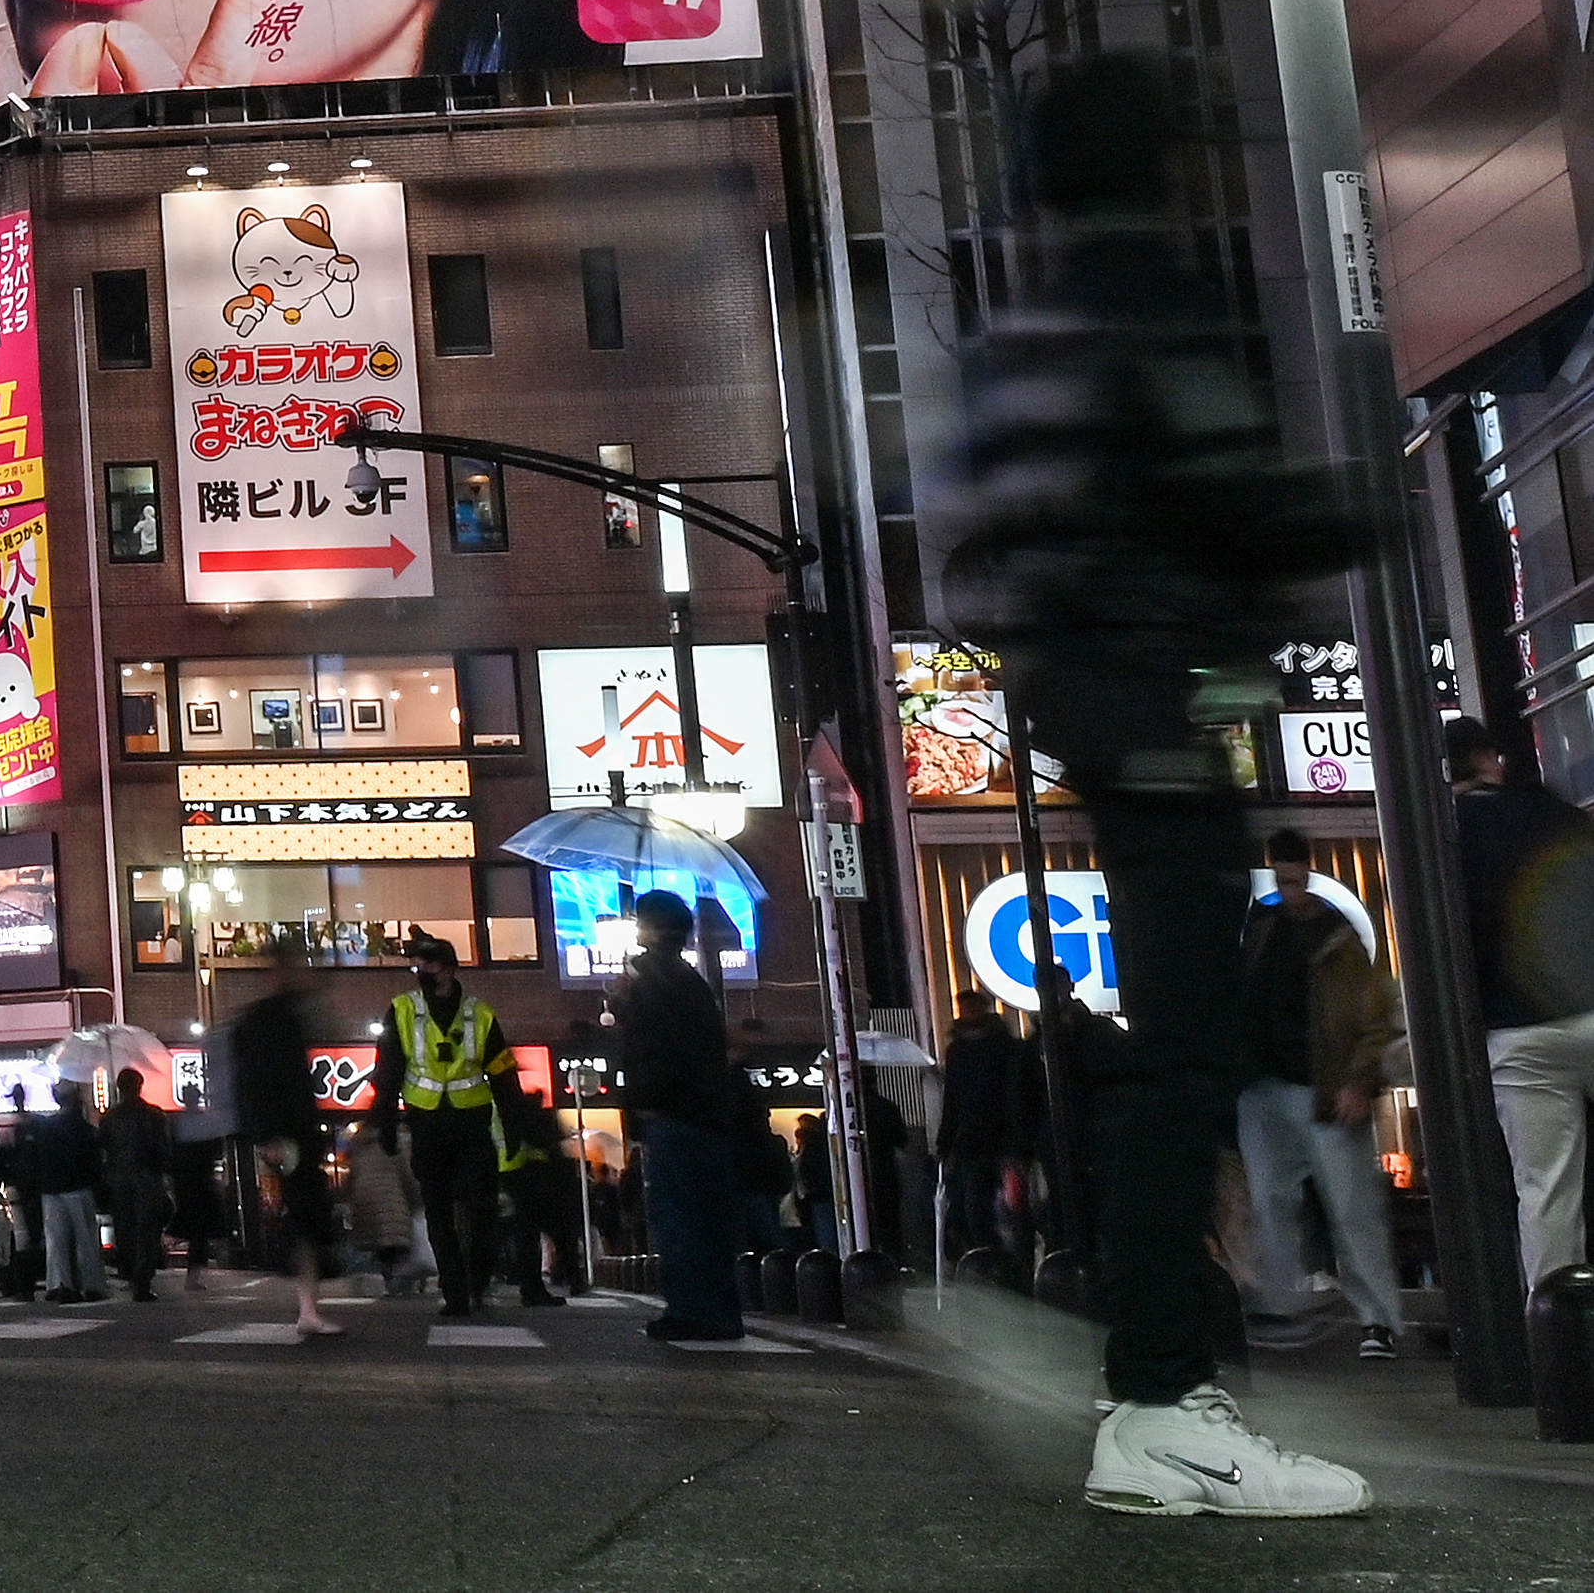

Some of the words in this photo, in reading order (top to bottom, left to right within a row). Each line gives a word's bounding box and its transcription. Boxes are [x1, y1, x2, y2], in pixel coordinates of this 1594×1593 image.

[0, 230, 15, 336] コンカフェ
[13, 219, 30, 333] キャバクラ
[217, 342, 370, 388] カラオケ
[197, 477, 332, 523] 隣ビル
[220, 802, 468, 824] 山下本気うどん
